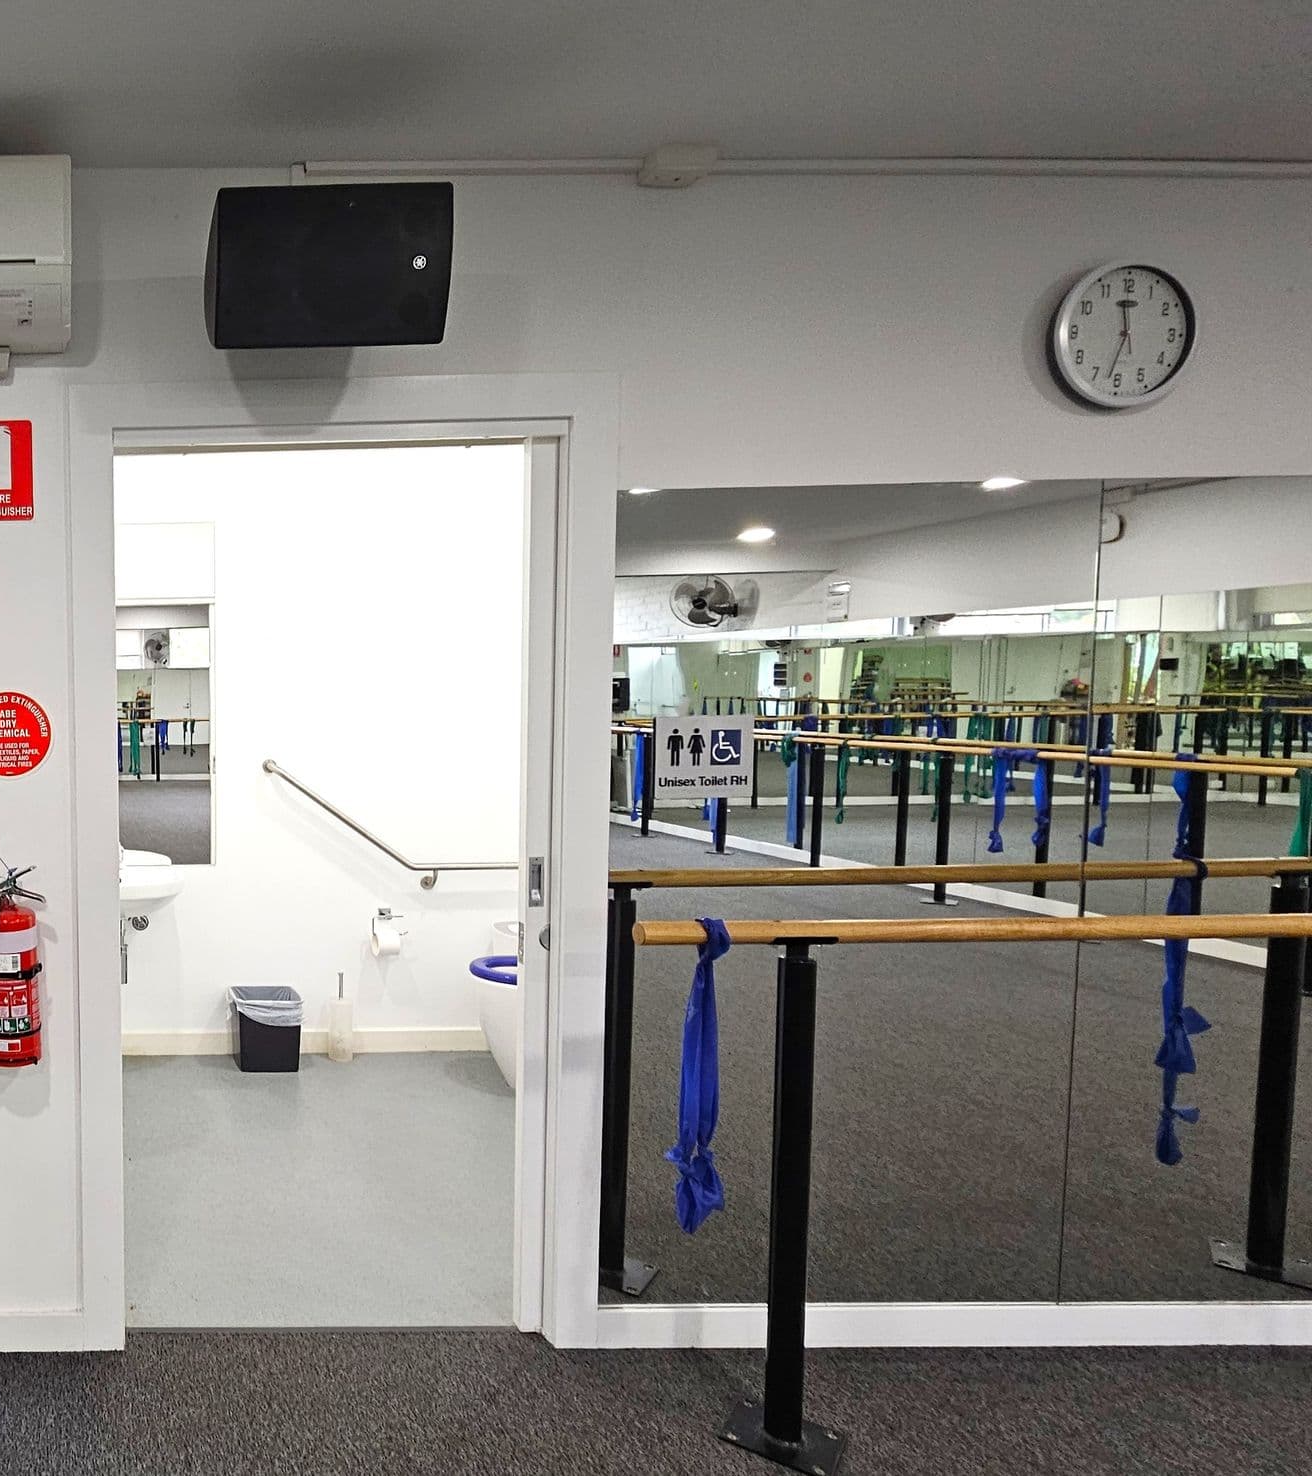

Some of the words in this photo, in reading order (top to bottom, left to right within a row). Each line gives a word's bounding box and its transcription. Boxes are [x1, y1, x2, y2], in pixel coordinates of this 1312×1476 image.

[1100, 283, 1111, 298] 11
[1122, 278, 1135, 293] 12
[1148, 285, 1153, 300] 1
[1080, 300, 1093, 315] 10
[1161, 302, 1170, 316] 2
[1070, 325, 1078, 340] 9
[1167, 327, 1176, 343] 3
[1075, 349, 1084, 365] 8
[1156, 351, 1165, 365] 4
[1092, 366, 1100, 381] 7
[1113, 373, 1122, 388] 6
[1137, 367, 1146, 382] 5
[0, 709, 17, 718] ABE
[11, 695, 48, 738] EXTINGUISHER
[0, 719, 17, 728] DRY
[658, 777, 696, 788] Unisex
[698, 775, 728, 786] Toilet
[730, 775, 748, 786] RH
